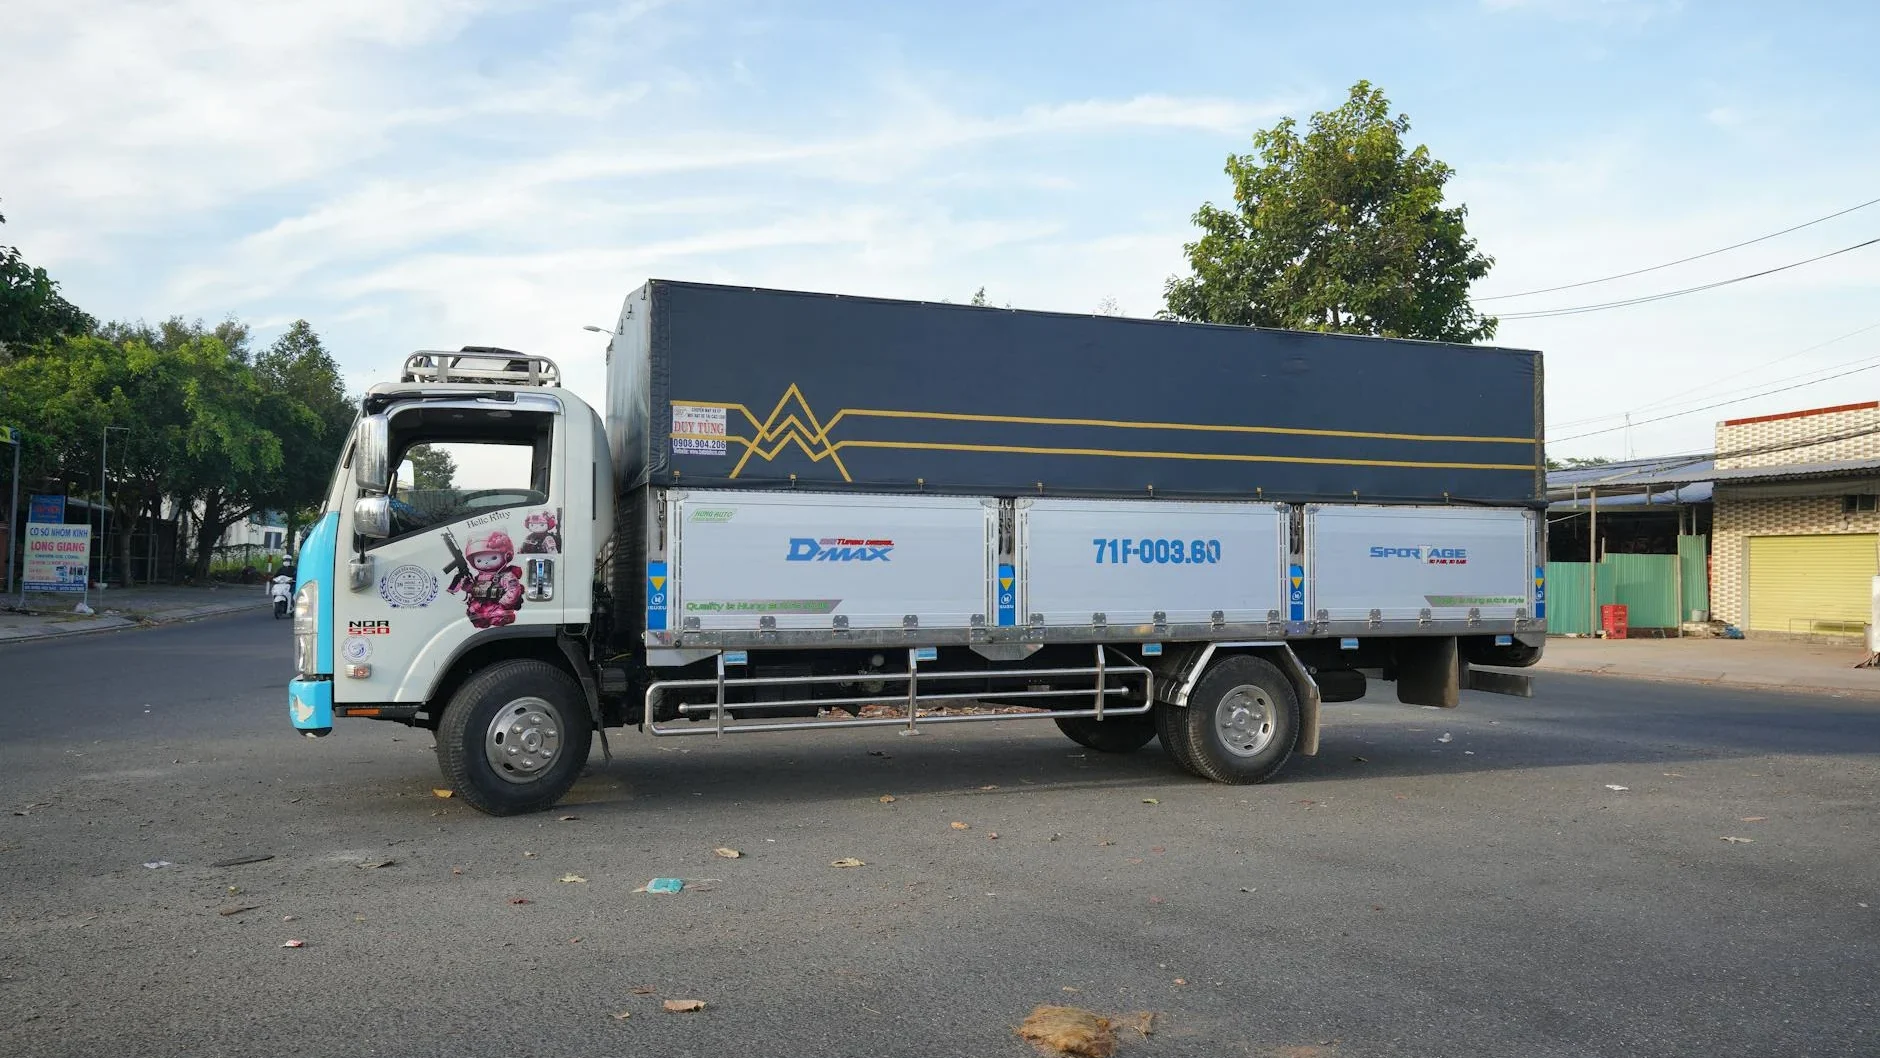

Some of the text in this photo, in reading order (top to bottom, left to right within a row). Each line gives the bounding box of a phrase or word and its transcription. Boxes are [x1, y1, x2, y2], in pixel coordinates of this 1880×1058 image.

[674, 421, 694, 433] DUY
[673, 438, 726, 449] 0908.904.206
[489, 511, 511, 522] Kitty
[31, 541, 85, 552] LONG GIANG
[837, 538, 865, 546] TURBO
[1093, 539, 1221, 564] 71F-003.60
[686, 602, 723, 612] Quality
[349, 620, 390, 628] NQR
[348, 627, 390, 635] 550
